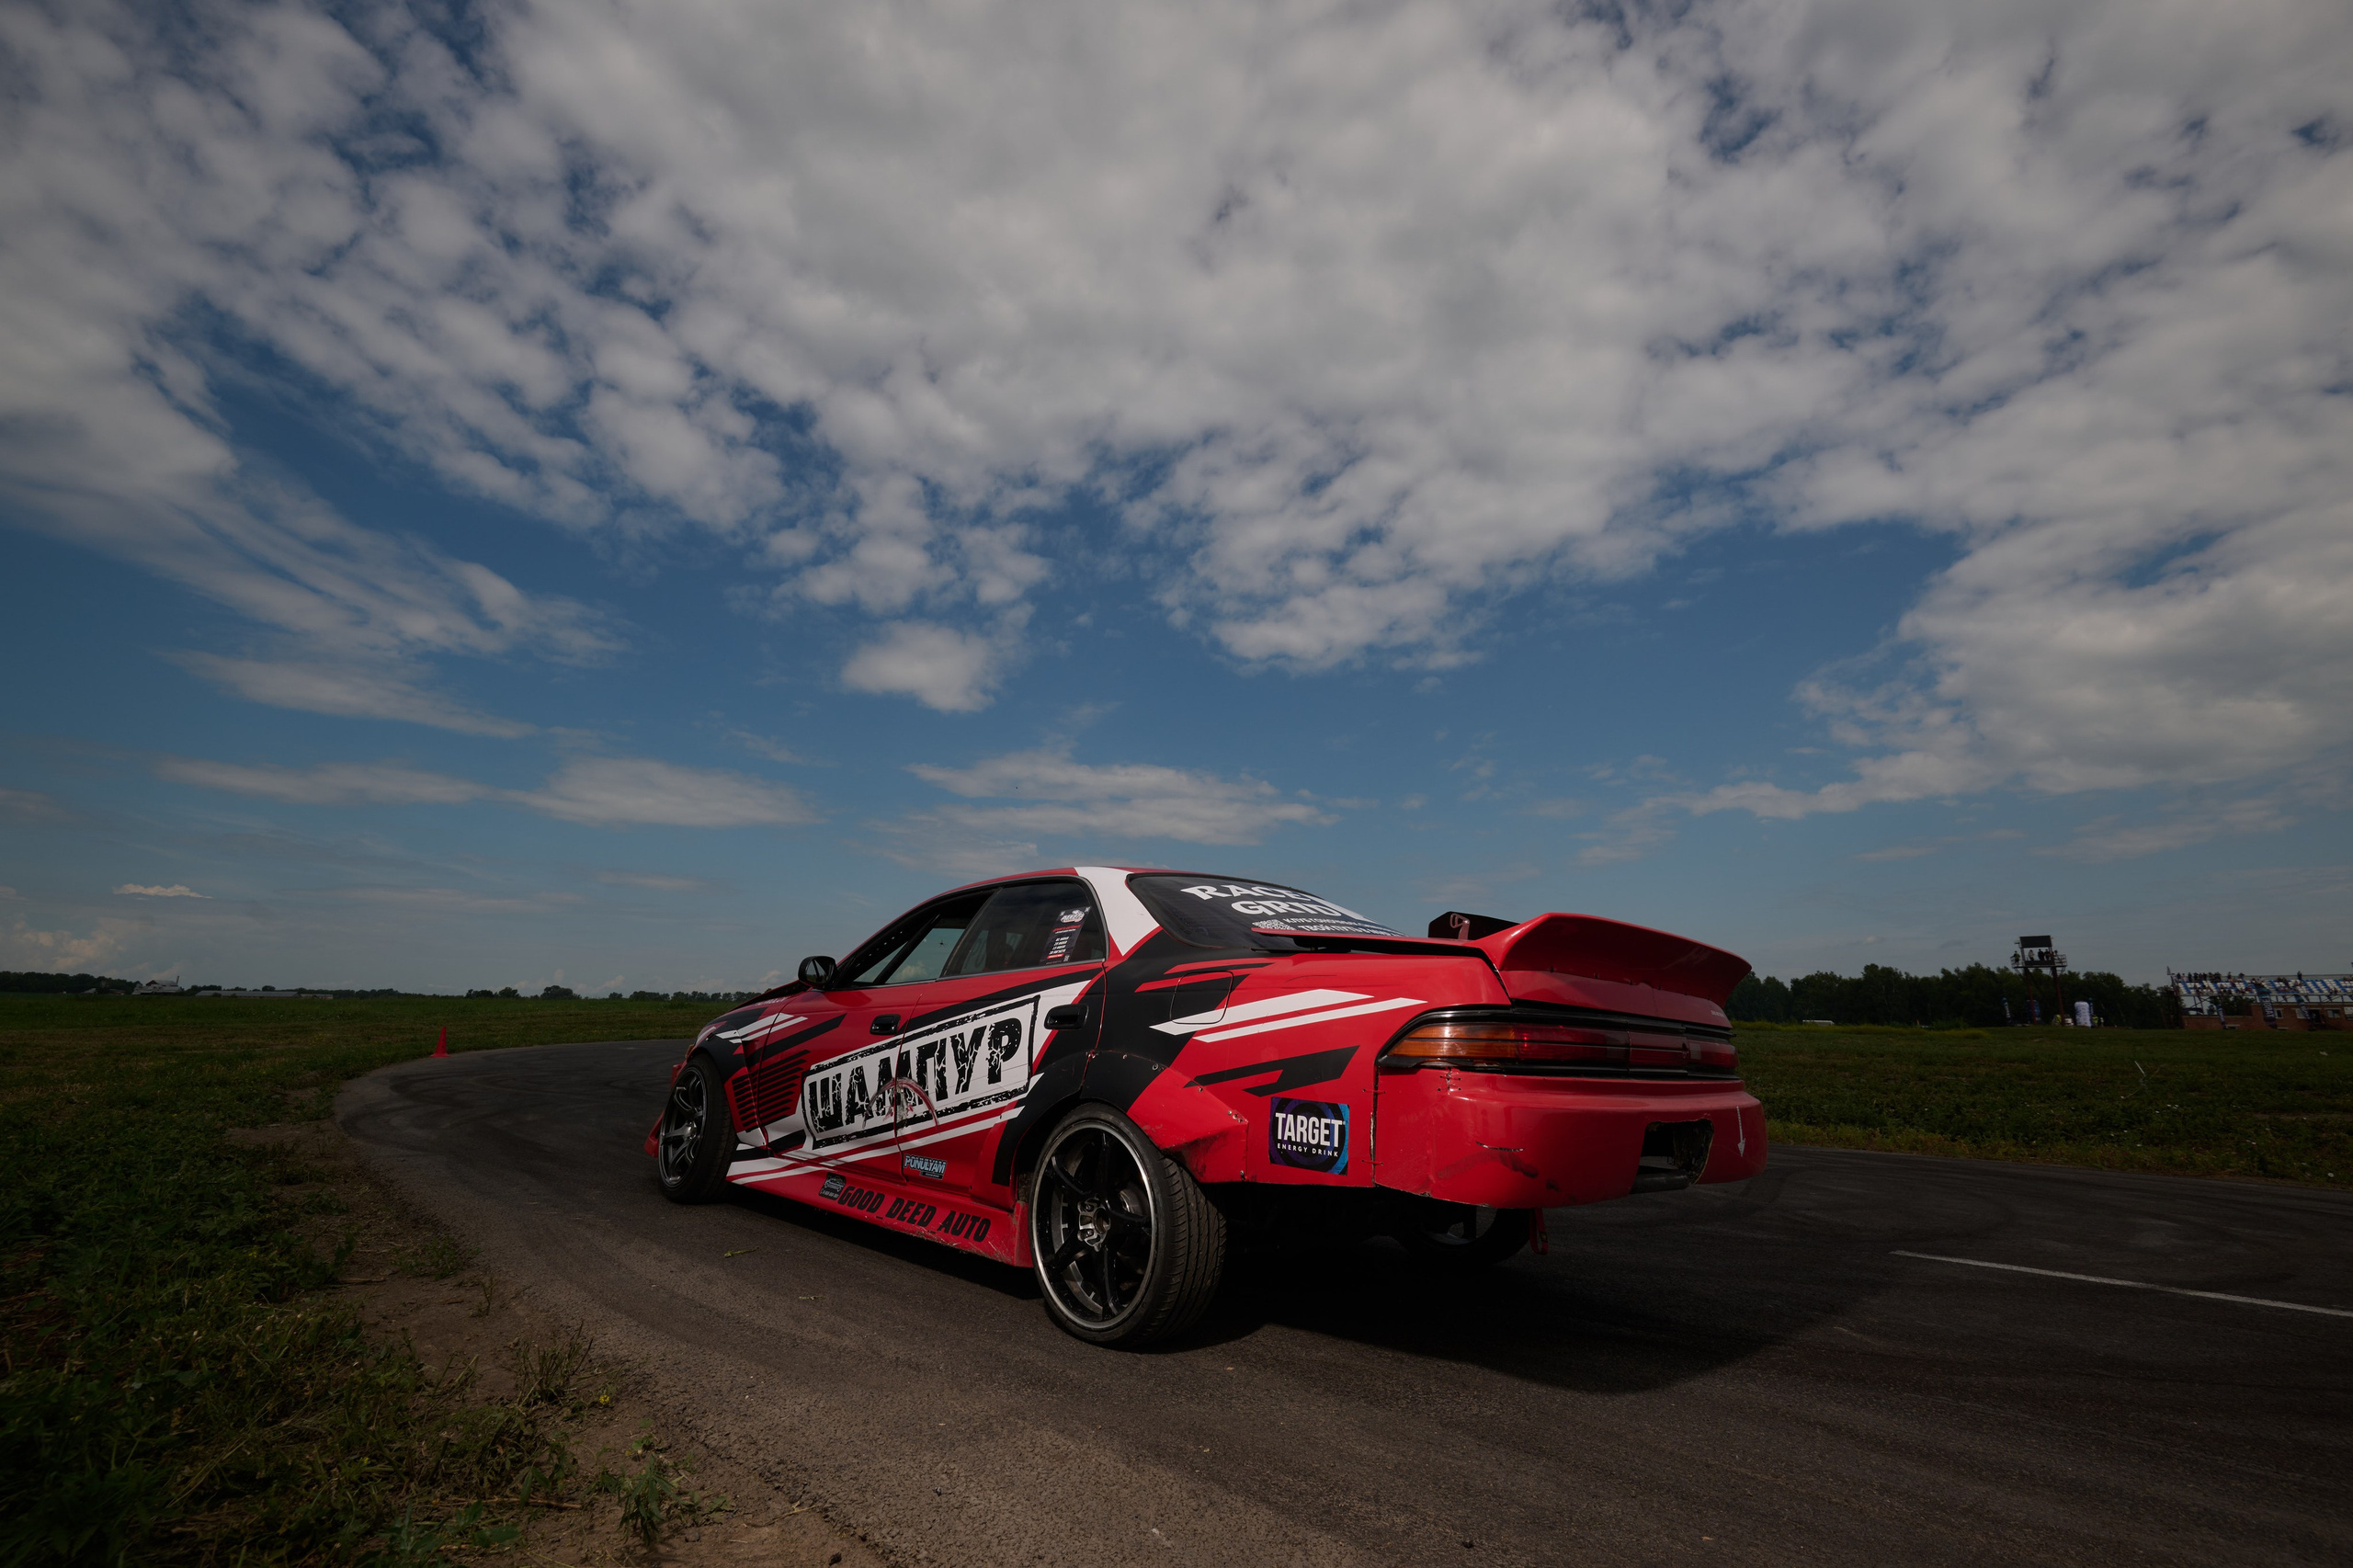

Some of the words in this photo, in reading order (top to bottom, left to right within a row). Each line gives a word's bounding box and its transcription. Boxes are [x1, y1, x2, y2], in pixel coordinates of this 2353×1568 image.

[1231, 901, 1342, 917] GRID
[809, 1017, 1022, 1133] ШАМПУР
[1275, 1112, 1343, 1148] TARGET
[1277, 1142, 1308, 1153] ENERGY
[1312, 1148, 1338, 1157] DRINK
